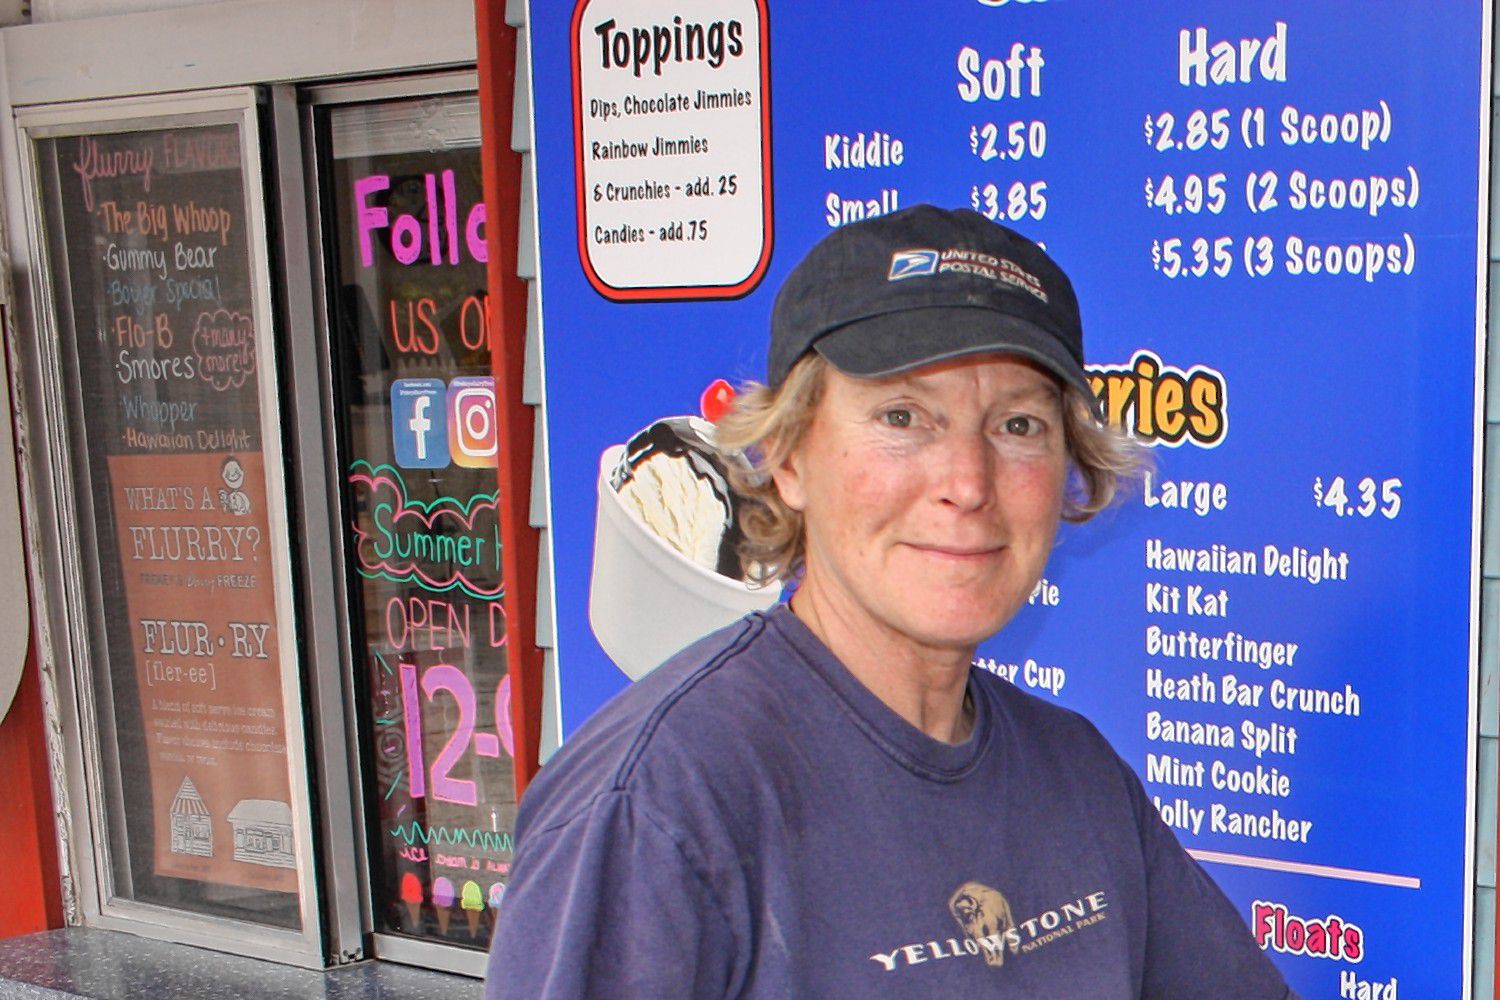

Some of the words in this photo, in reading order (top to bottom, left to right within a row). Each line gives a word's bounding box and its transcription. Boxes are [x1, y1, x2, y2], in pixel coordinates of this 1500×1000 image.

[594, 16, 744, 76] Toppings
[1178, 21, 1287, 87] Hard
[957, 43, 1045, 102] Soft
[590, 97, 621, 121] Dips,
[624, 93, 690, 116] Chocolate
[693, 88, 752, 110] Jimmies
[592, 138, 649, 161] Rainbow
[652, 135, 708, 157] Jimmies
[825, 132, 904, 170] Kiddie
[969, 121, 1046, 162] $2.50
[1143, 107, 1230, 151] $2.85
[1280, 101, 1392, 151] Scoop)
[606, 179, 670, 201] Crunchies
[826, 188, 898, 228] Small
[971, 179, 1048, 222] $3.85
[1143, 172, 1228, 216] $4.95
[1288, 166, 1420, 217] Scoops)
[101, 201, 132, 235] The
[137, 201, 168, 242] Big
[173, 200, 232, 246] Whoop
[595, 224, 645, 245] Candies
[106, 243, 168, 280] Gummy
[174, 241, 218, 270] Bear
[938, 261, 998, 280] POSTAL
[940, 248, 999, 267] UNITED
[1000, 257, 1042, 288] STATES
[1151, 237, 1233, 280] $5.35
[1285, 233, 1416, 282] Scoops)
[118, 350, 195, 384] Smores
[124, 486, 193, 511] WHAT'S
[200, 487, 216, 511] A
[1143, 472, 1229, 516] Large
[1313, 476, 1402, 520] $4.35
[129, 525, 261, 562] FLURRY?
[374, 502, 486, 567] Summer
[217, 574, 257, 589] FREEZE
[1145, 539, 1257, 577] Hawaiian
[1263, 544, 1350, 584] Delight
[1145, 582, 1183, 616] Kit
[1187, 583, 1230, 618] Kat
[386, 596, 470, 650] OPEN
[1145, 625, 1299, 669] Butterfinger
[1023, 657, 1067, 697] Cup
[1145, 668, 1216, 703] Heath
[1221, 676, 1263, 709] Bar
[1270, 677, 1361, 717] Crunch
[1145, 710, 1235, 750] Banana
[1240, 716, 1298, 759] Split
[1146, 753, 1204, 788] Mint
[1210, 759, 1292, 799] Cookie
[1210, 802, 1313, 844] Rancher
[869, 889, 1110, 972] YELLOWSTONE
[1021, 923, 1075, 953] NATIONAL
[1075, 910, 1107, 931] PARK
[1253, 901, 1363, 962] Floats
